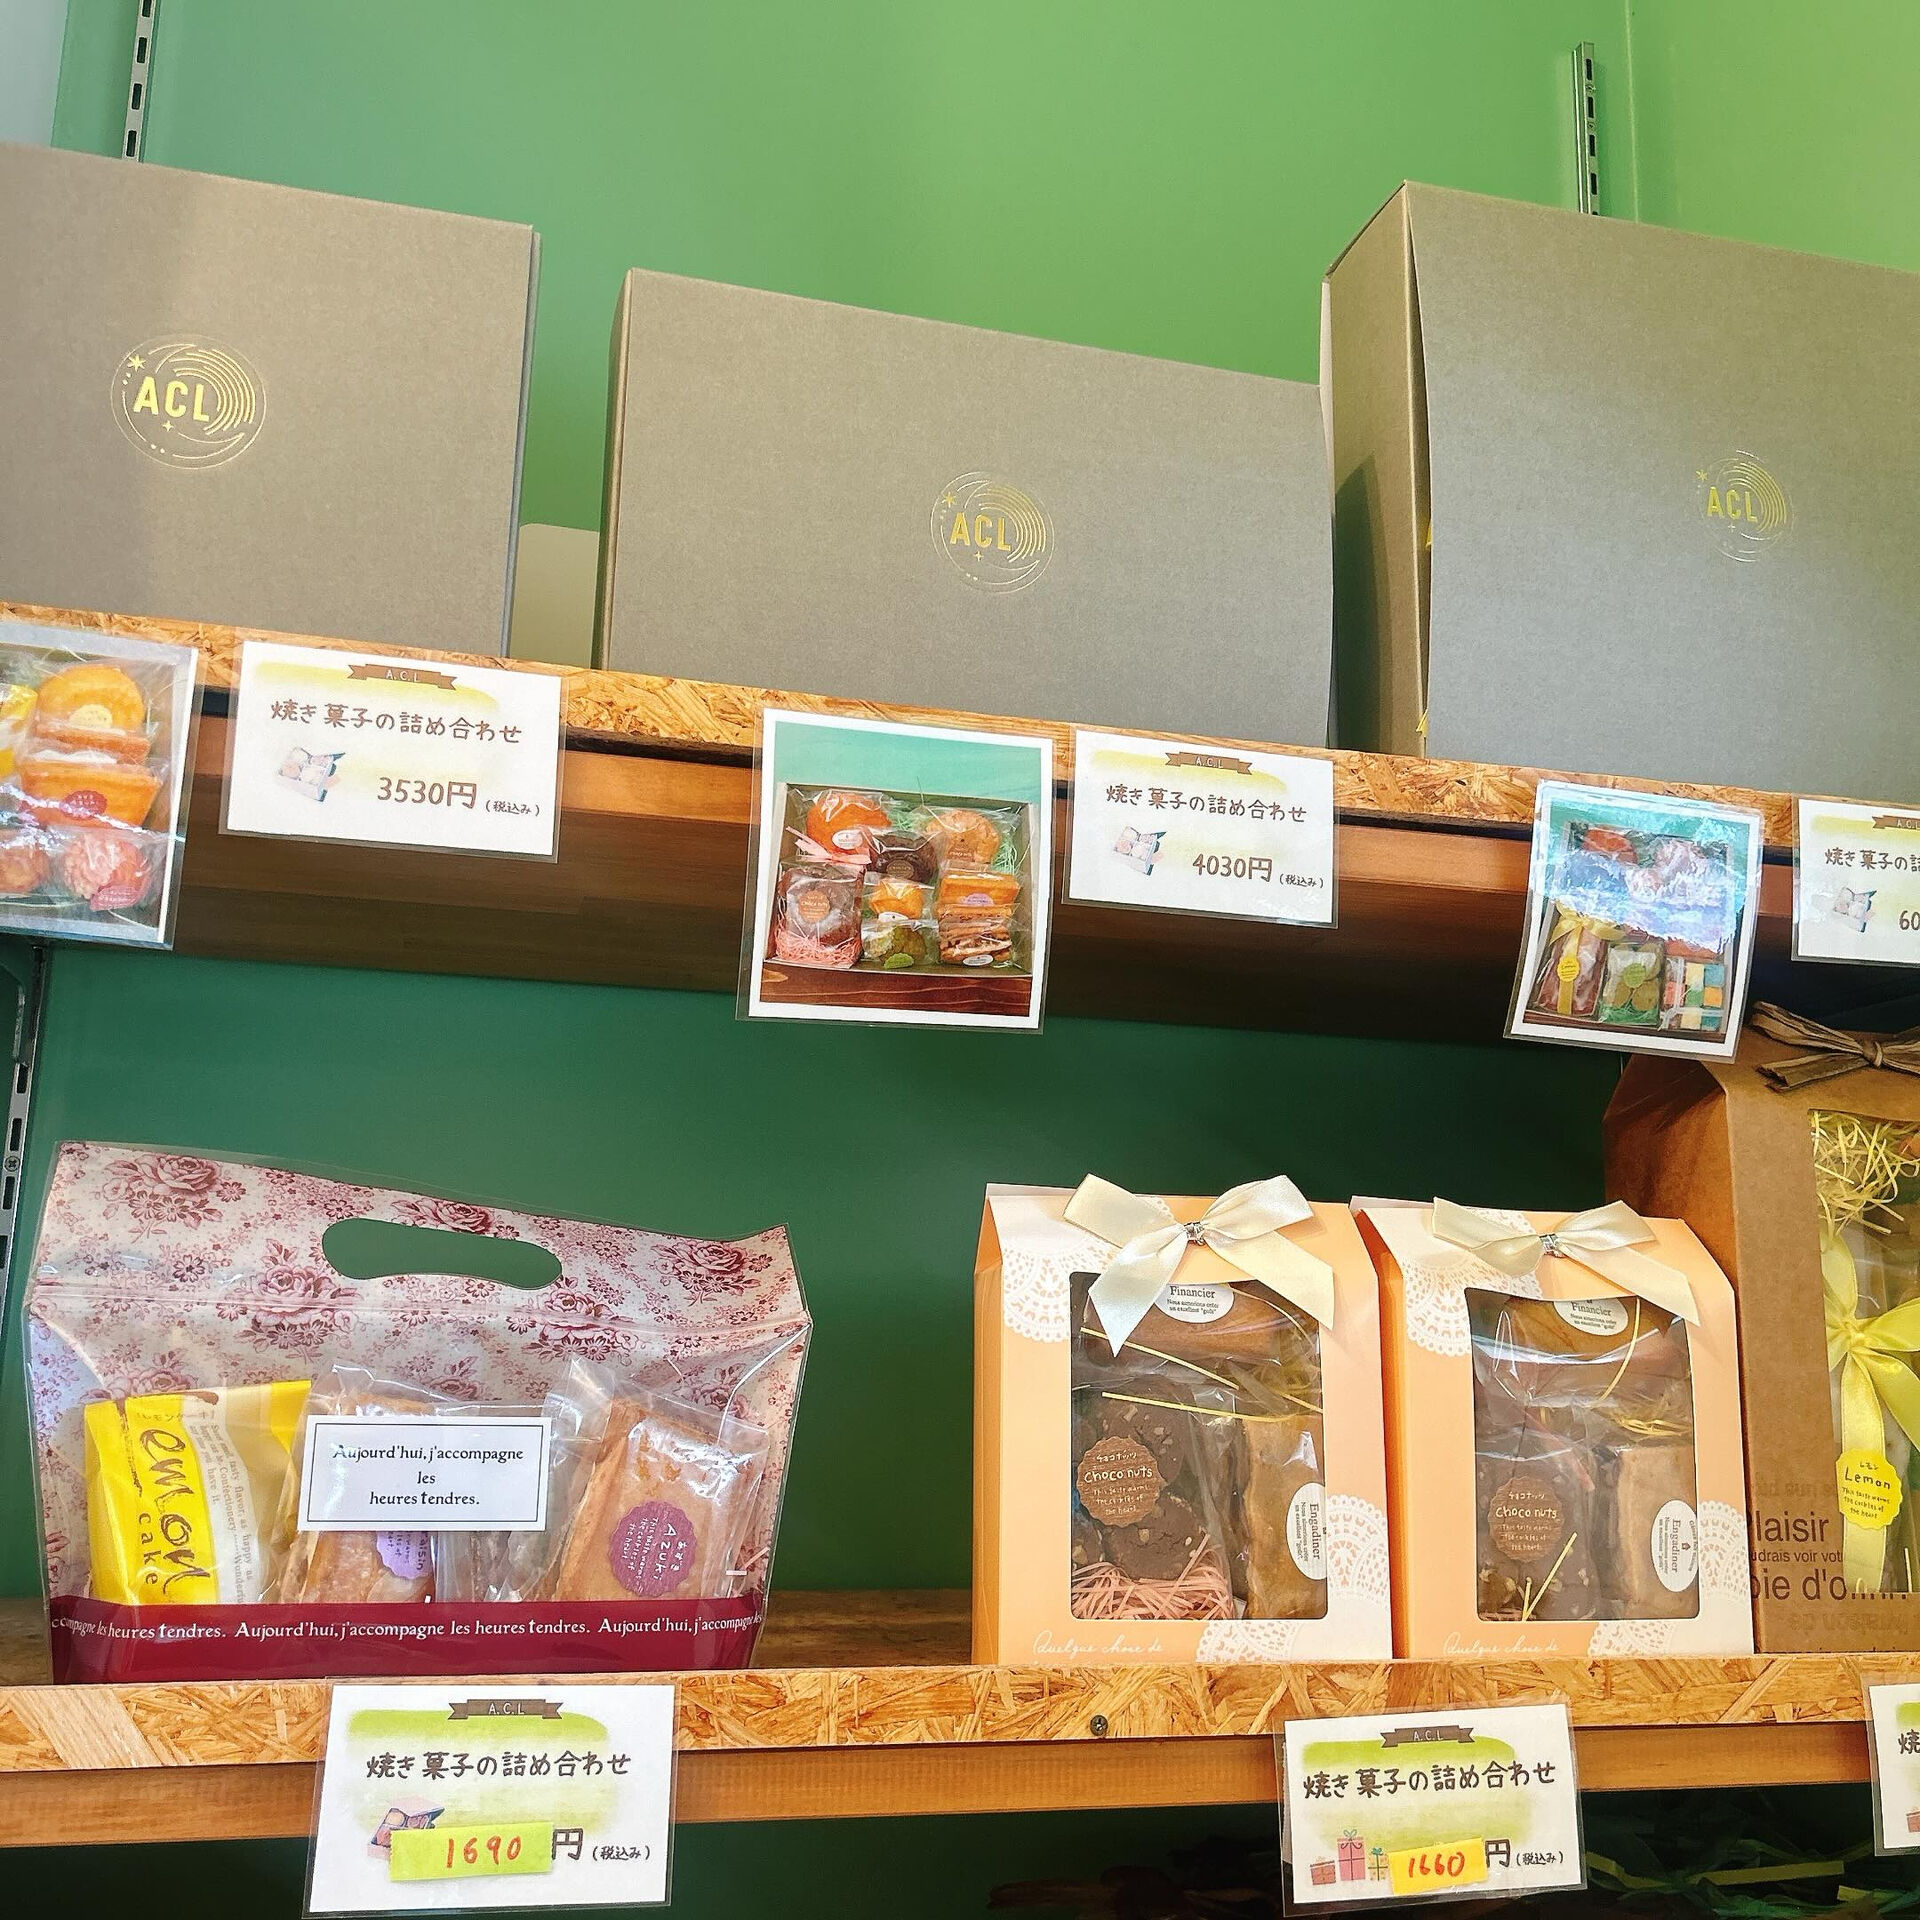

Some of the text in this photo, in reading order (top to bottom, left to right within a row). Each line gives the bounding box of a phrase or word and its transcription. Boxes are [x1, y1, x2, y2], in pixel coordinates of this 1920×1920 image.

[133, 376, 210, 422] ACL
[1706, 486, 1758, 523] ACL
[950, 512, 1011, 552] ACL
[270, 699, 522, 743] 焼き菓子の詰め合わせ
[377, 777, 478, 809] 3530円
[1106, 784, 1307, 823] 焼き菓子の詰め合わせ
[1192, 853, 1272, 882] 4030円
[1169, 1285, 1216, 1298] Financier
[417, 1471, 436, 1485] les
[1127, 1466, 1153, 1478] nuts
[1845, 1466, 1890, 1489] Lemon
[369, 1491, 480, 1505] heures tendres.
[1534, 1508, 1557, 1519] nuts
[1310, 1503, 1321, 1559] Engadiner
[138, 1512, 161, 1584] cake
[242, 1534, 252, 1564] happy
[653, 1523, 677, 1580] Azuki
[1794, 1549, 1818, 1562] voir
[1821, 1551, 1843, 1562] vot
[97, 1620, 108, 1636] les
[108, 1622, 155, 1639] heures
[159, 1623, 226, 1638] tendres.
[451, 1620, 470, 1635] les
[475, 1620, 525, 1634] heures
[529, 1619, 590, 1634] tendres.
[366, 1749, 631, 1780] 焼き菓子の詰め合わせ
[1303, 1760, 1556, 1799] 焼き菓子の詰め合わせ
[446, 1835, 522, 1868] 1690
[1408, 1851, 1466, 1878] 1660
